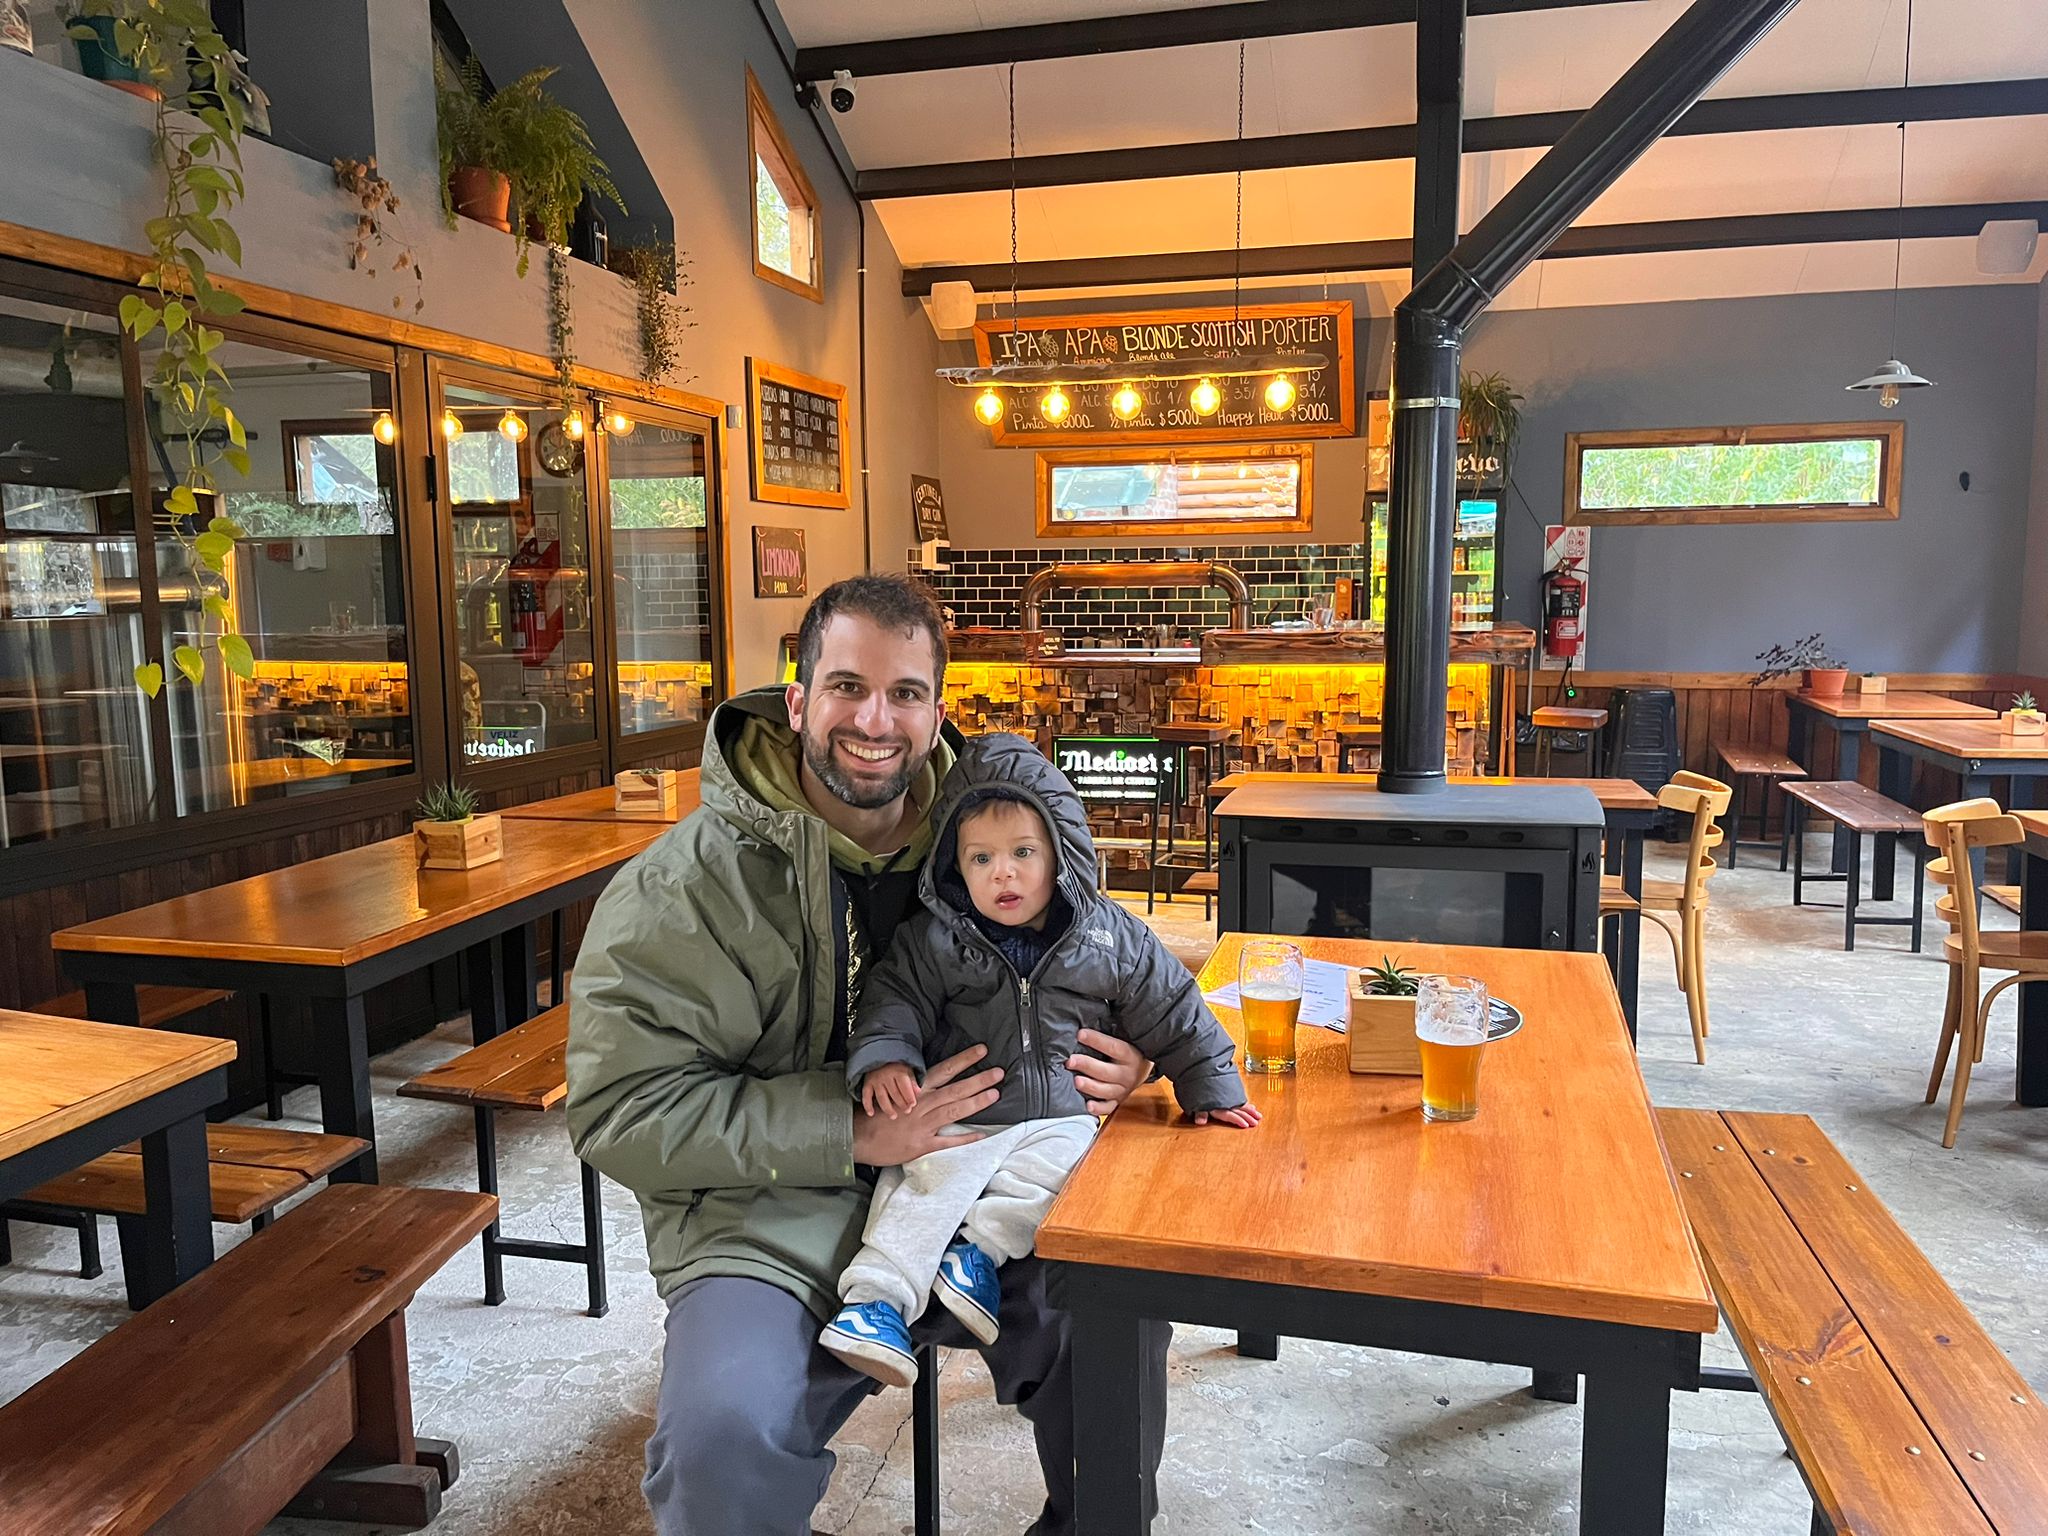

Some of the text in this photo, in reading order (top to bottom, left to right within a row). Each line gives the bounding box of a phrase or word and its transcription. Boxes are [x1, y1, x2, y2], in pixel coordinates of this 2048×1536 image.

[998, 331, 1042, 358] IPA
[1065, 328, 1105, 356] APA
[1122, 324, 1189, 352] BLONDE
[1262, 316, 1332, 346] PORTER
[1012, 413, 1048, 431] Pinta
[1217, 409, 1255, 426] Happy
